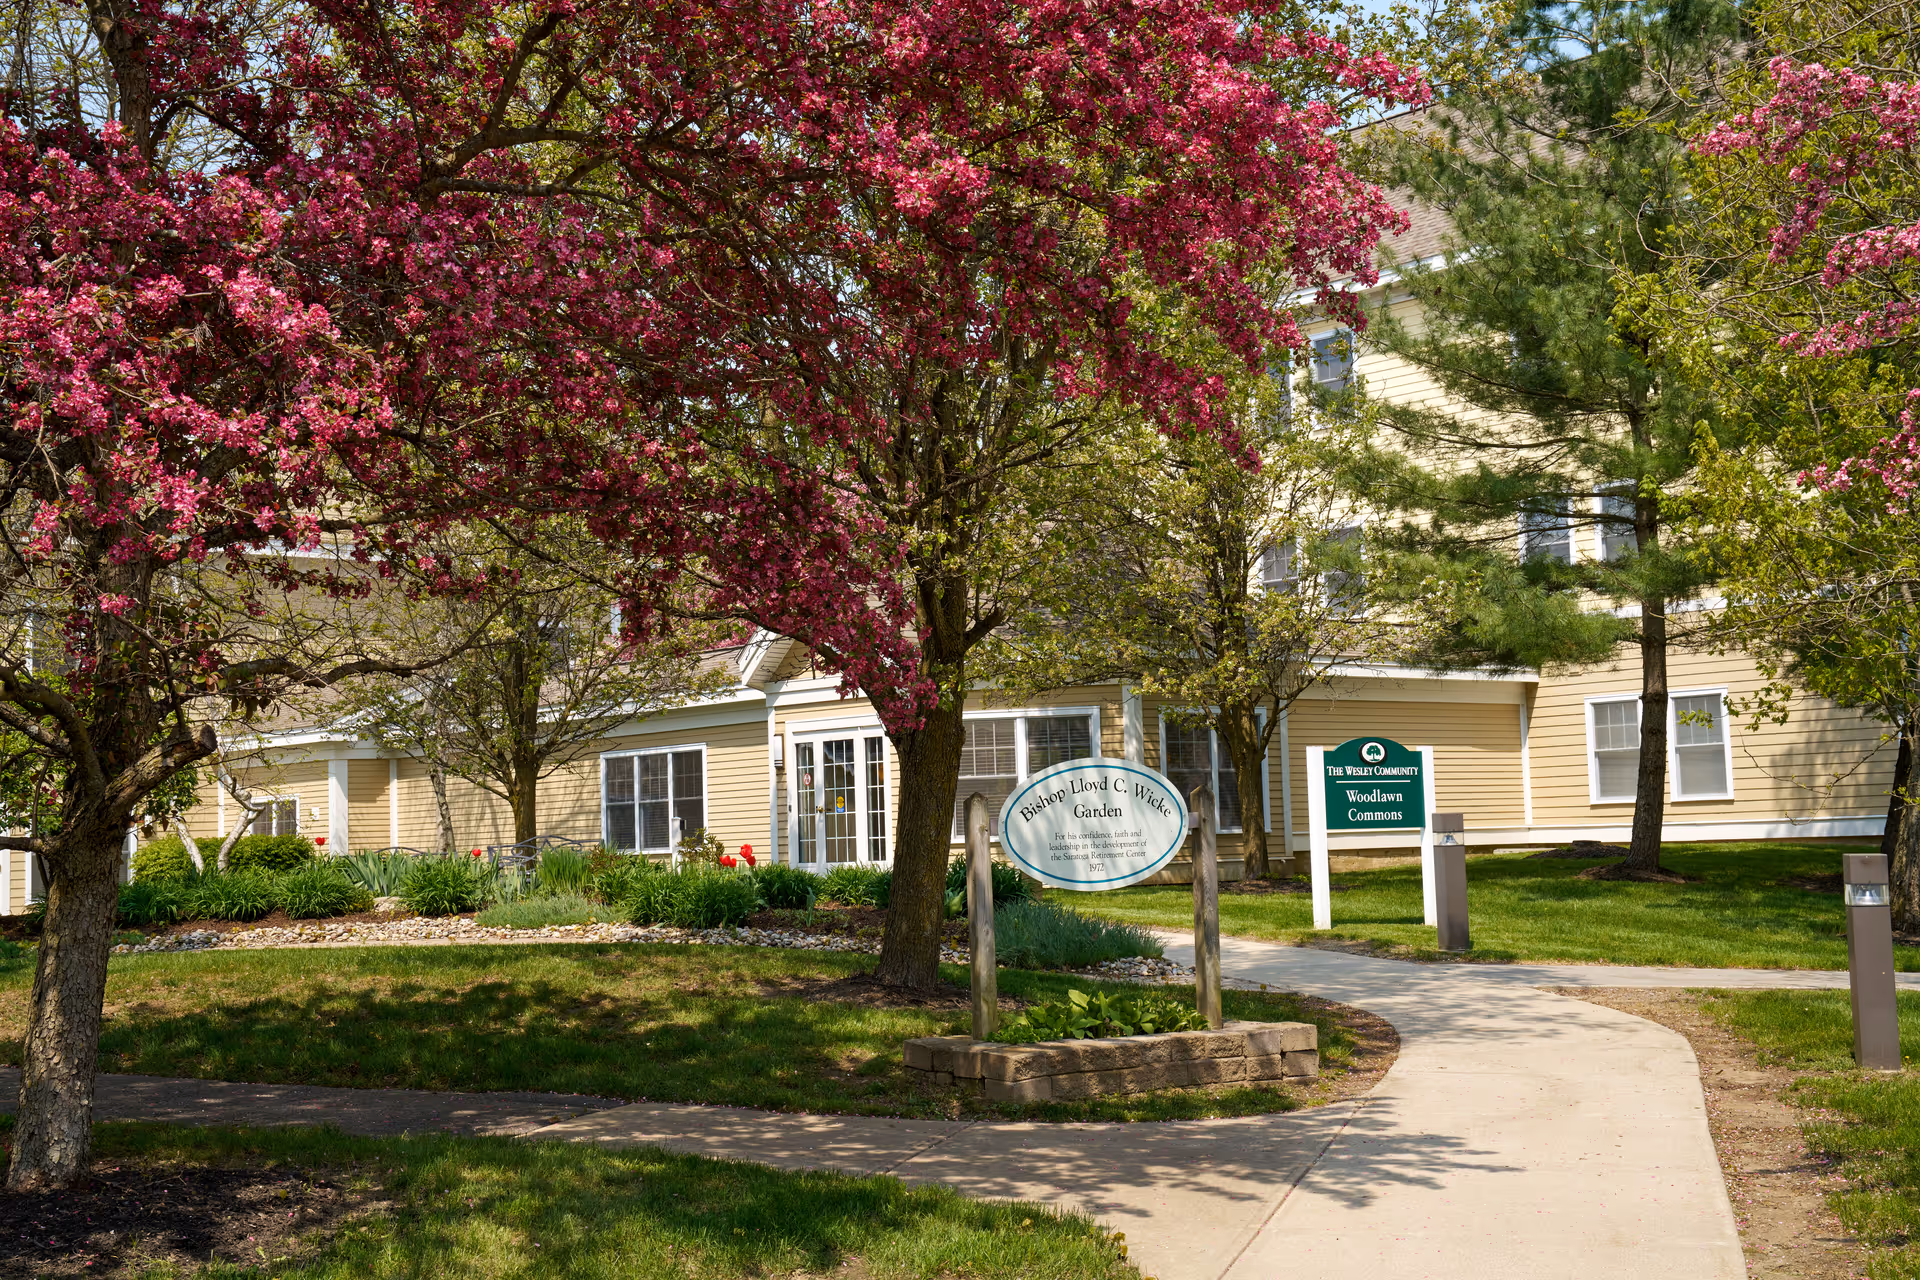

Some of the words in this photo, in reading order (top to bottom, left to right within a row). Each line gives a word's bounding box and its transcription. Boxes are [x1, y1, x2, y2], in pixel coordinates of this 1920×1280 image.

[1327, 766, 1343, 776] THE
[1345, 766, 1373, 776] WESLEY
[1374, 766, 1418, 776] COMMUNITY
[1019, 788, 1066, 822] Bishop
[1070, 777, 1108, 794] Lloyd
[1114, 778, 1127, 793] C.
[1134, 783, 1171, 818] Wicke
[1346, 789, 1403, 803] Woodlawn
[1073, 803, 1122, 819] Garden
[1348, 808, 1402, 821] Commons
[1055, 832, 1066, 840] For
[1079, 831, 1112, 839] confidence,
[1114, 830, 1128, 838] faith
[1130, 829, 1142, 837] and
[1049, 842, 1080, 851] leadership
[1090, 841, 1101, 849] the
[1102, 840, 1139, 850] development
[1051, 853, 1061, 861] the
[1063, 852, 1089, 861] Saratoga
[1092, 851, 1124, 859] Retirement
[1126, 850, 1146, 858] Center
[1089, 863, 1104, 872] 1972
